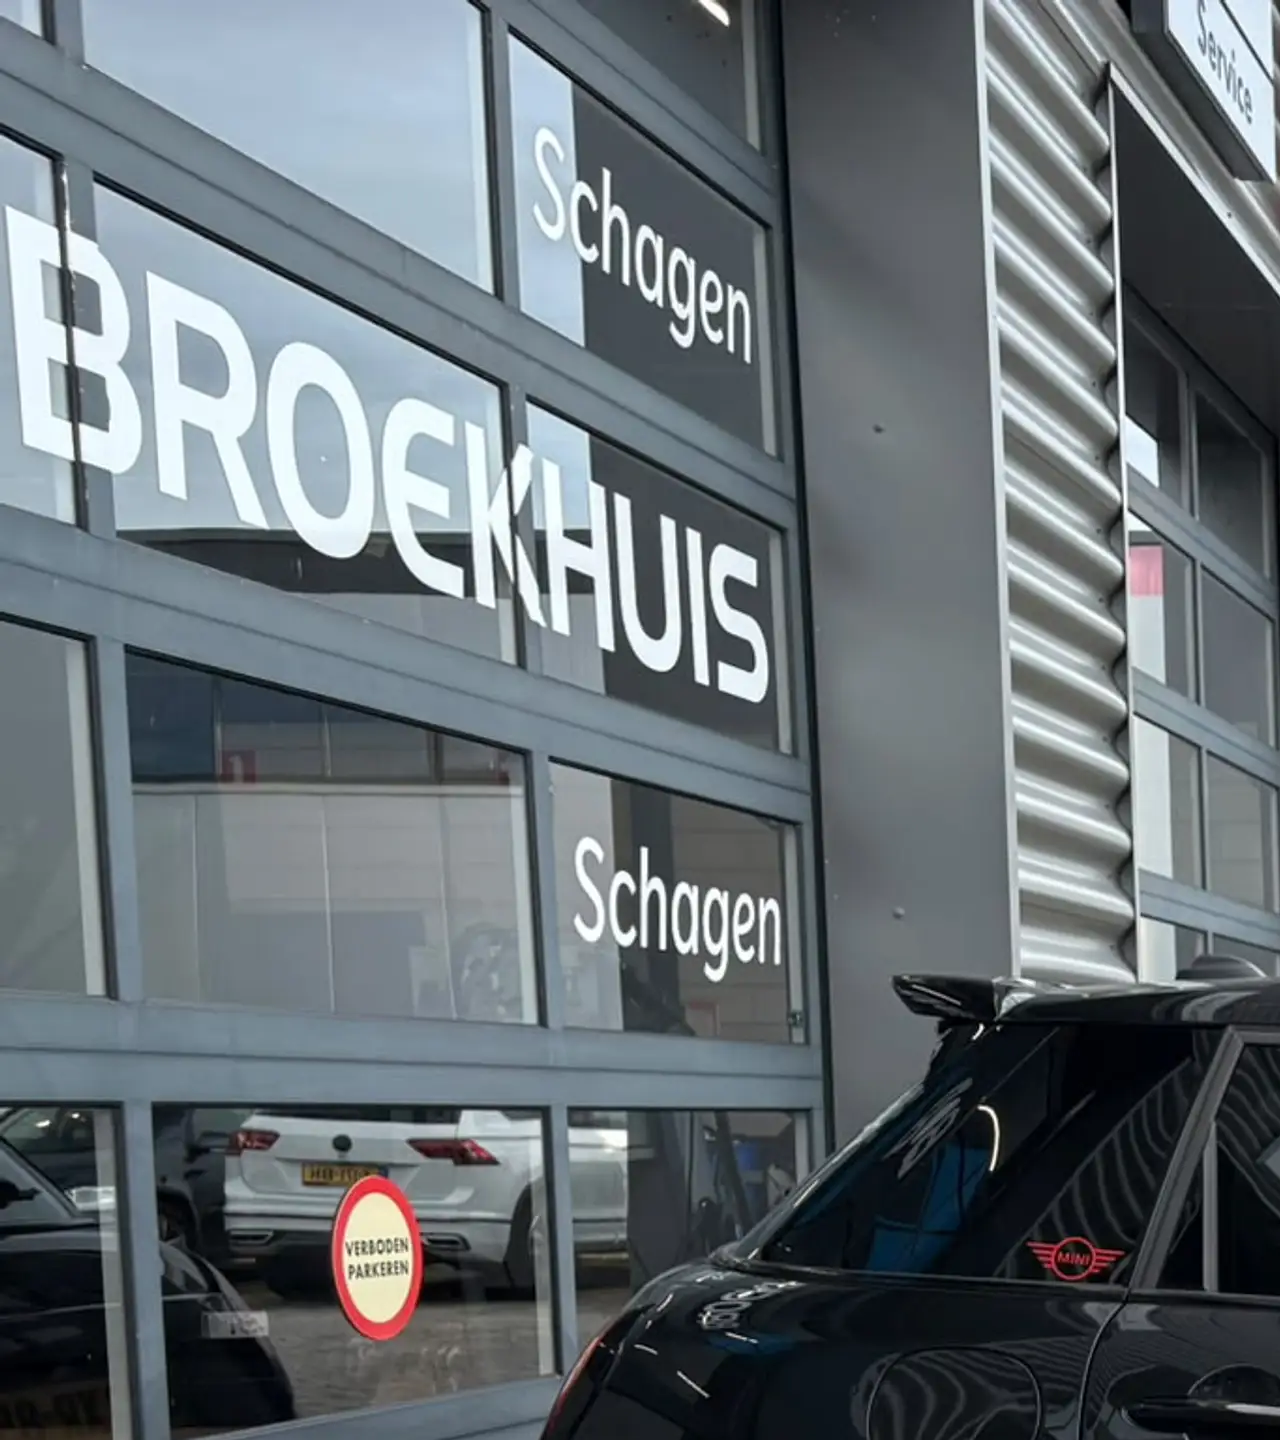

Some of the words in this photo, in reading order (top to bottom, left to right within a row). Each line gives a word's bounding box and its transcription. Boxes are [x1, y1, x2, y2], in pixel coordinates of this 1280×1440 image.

[1197, 0, 1253, 124] Service
[533, 127, 752, 363] Schagen
[5, 206, 769, 703] BROEKHUIS
[574, 837, 782, 983] Schagen
[345, 1238, 409, 1257] VERBODEN
[347, 1261, 409, 1280] PARKEREN
[1057, 1251, 1090, 1264] MINI
